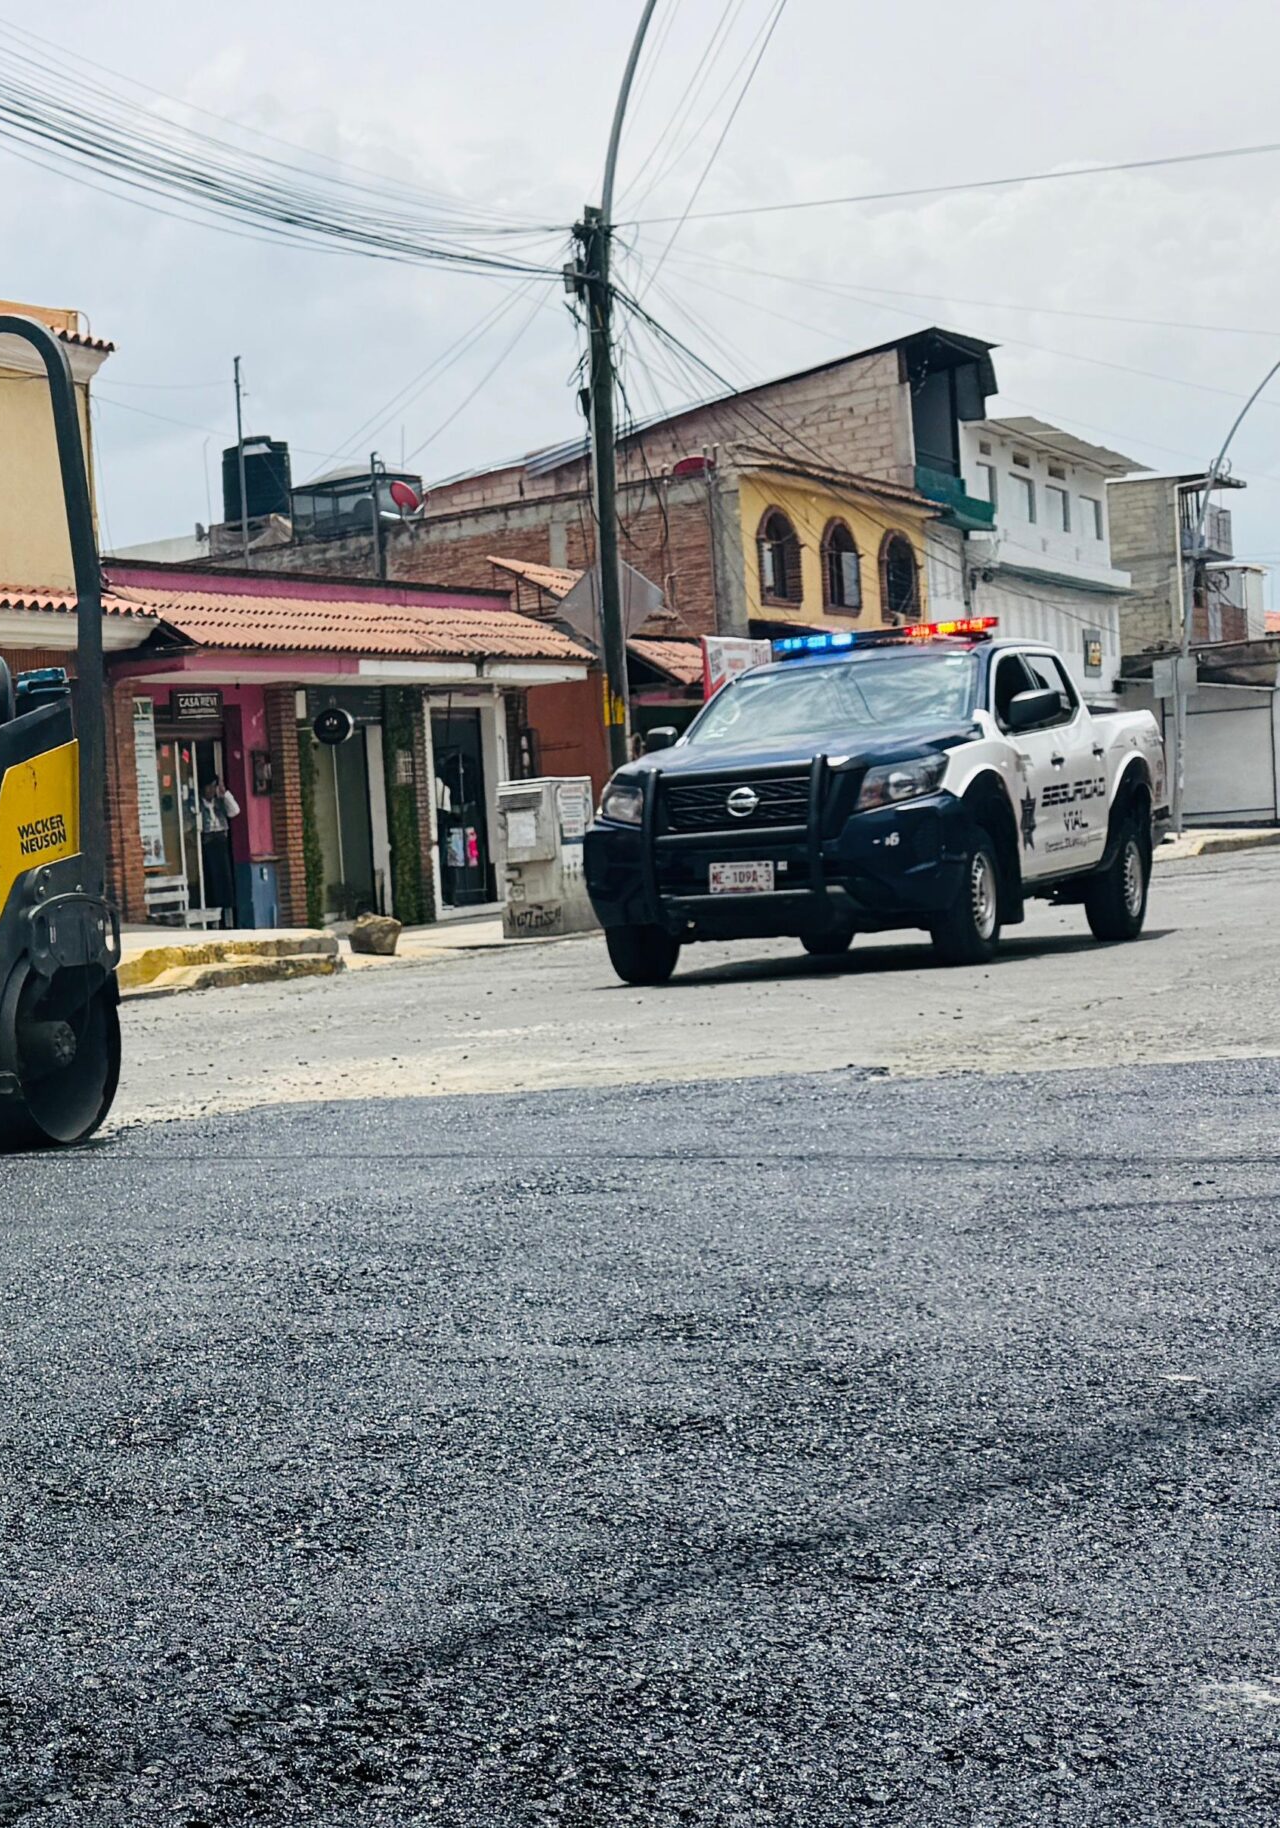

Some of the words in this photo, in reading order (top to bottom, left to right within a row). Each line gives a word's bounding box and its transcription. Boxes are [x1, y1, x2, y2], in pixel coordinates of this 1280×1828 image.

[179, 697, 200, 707] CASA
[17, 813, 65, 839] WACKER
[20, 828, 67, 855] NEUSON
